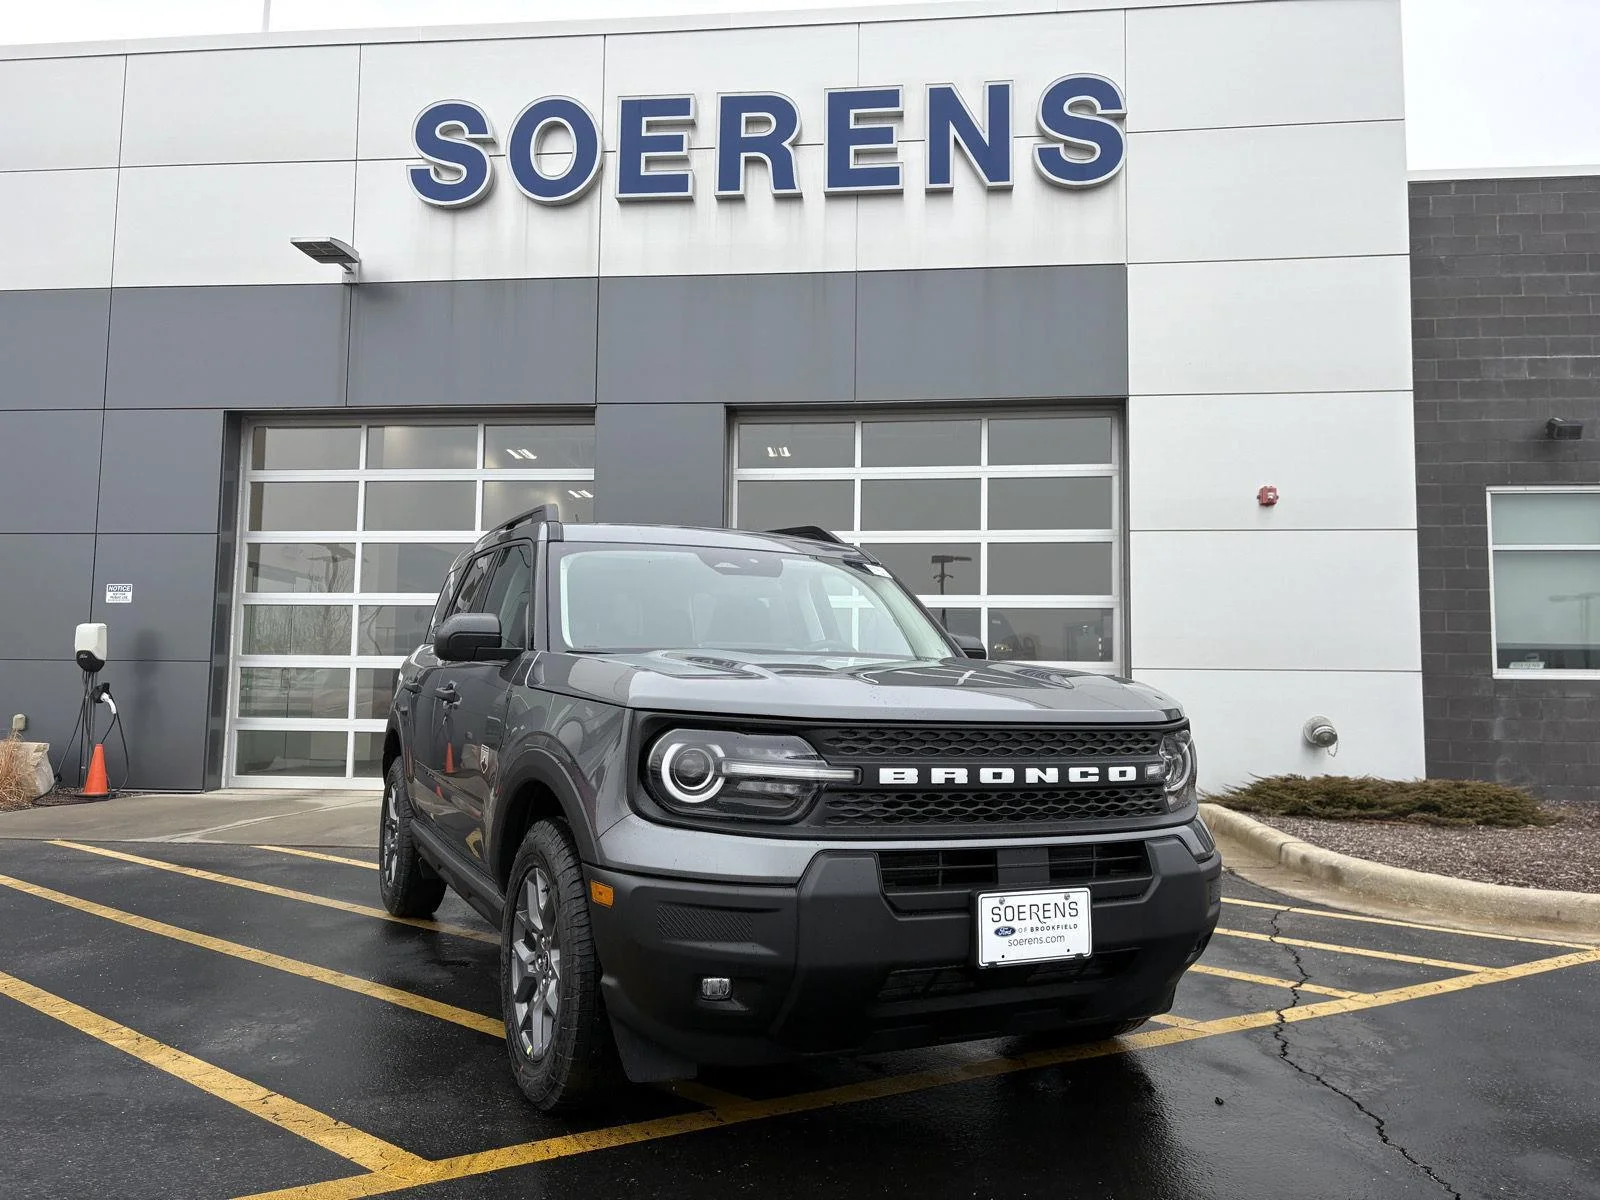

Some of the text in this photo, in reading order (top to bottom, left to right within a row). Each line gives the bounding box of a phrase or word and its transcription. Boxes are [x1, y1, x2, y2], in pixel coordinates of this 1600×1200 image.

[406, 73, 1127, 207] SOERENS
[879, 766, 1137, 785] BRONCO
[991, 901, 1079, 924] SOERENS
[997, 924, 1078, 936] Ford OF BROOKFIELD
[1008, 935, 1065, 947] soerens.com
